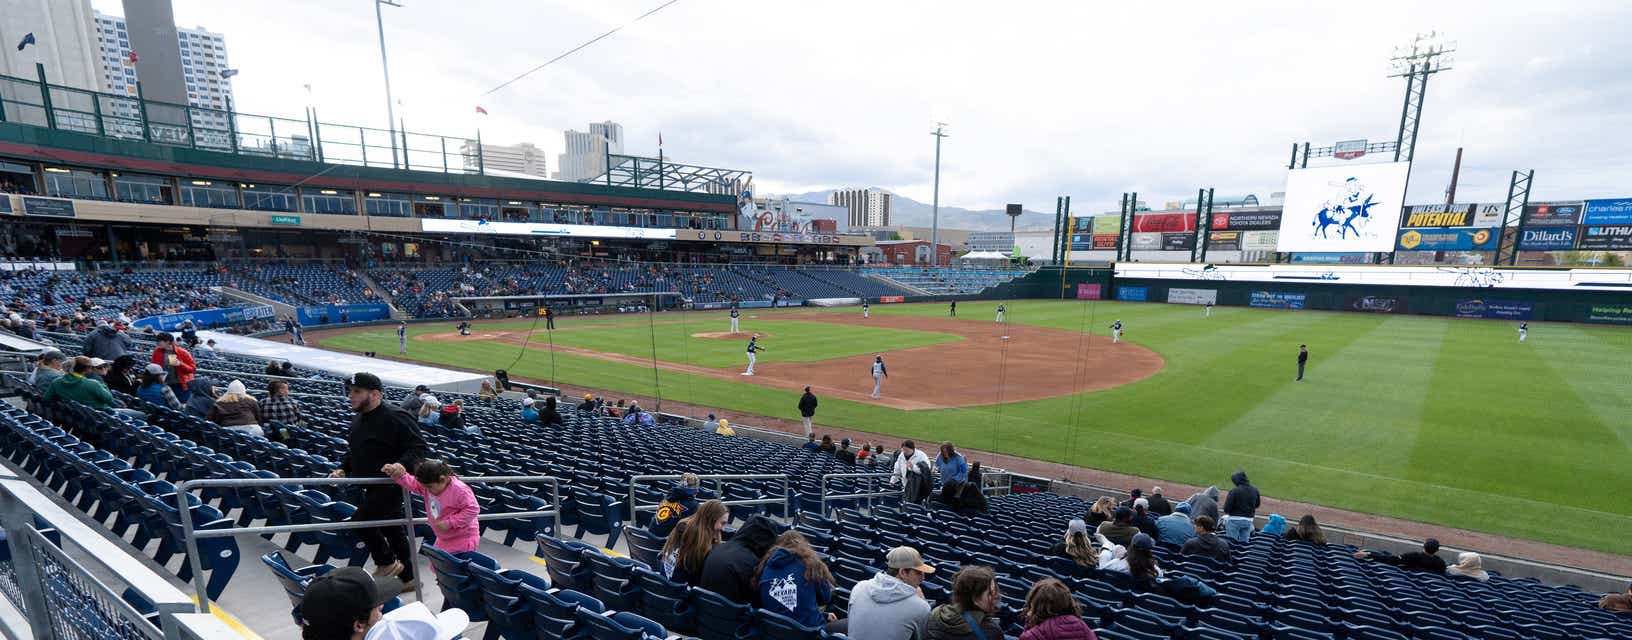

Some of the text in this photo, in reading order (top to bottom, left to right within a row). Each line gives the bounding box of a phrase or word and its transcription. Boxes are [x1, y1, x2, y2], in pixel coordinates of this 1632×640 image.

[1412, 204, 1470, 213] UNLEASH YOUR
[1407, 213, 1467, 227] POTENTIAL
[1523, 231, 1573, 241] Dillard's
[245, 307, 273, 319] GREATER
[773, 589, 796, 598] NEVADA
